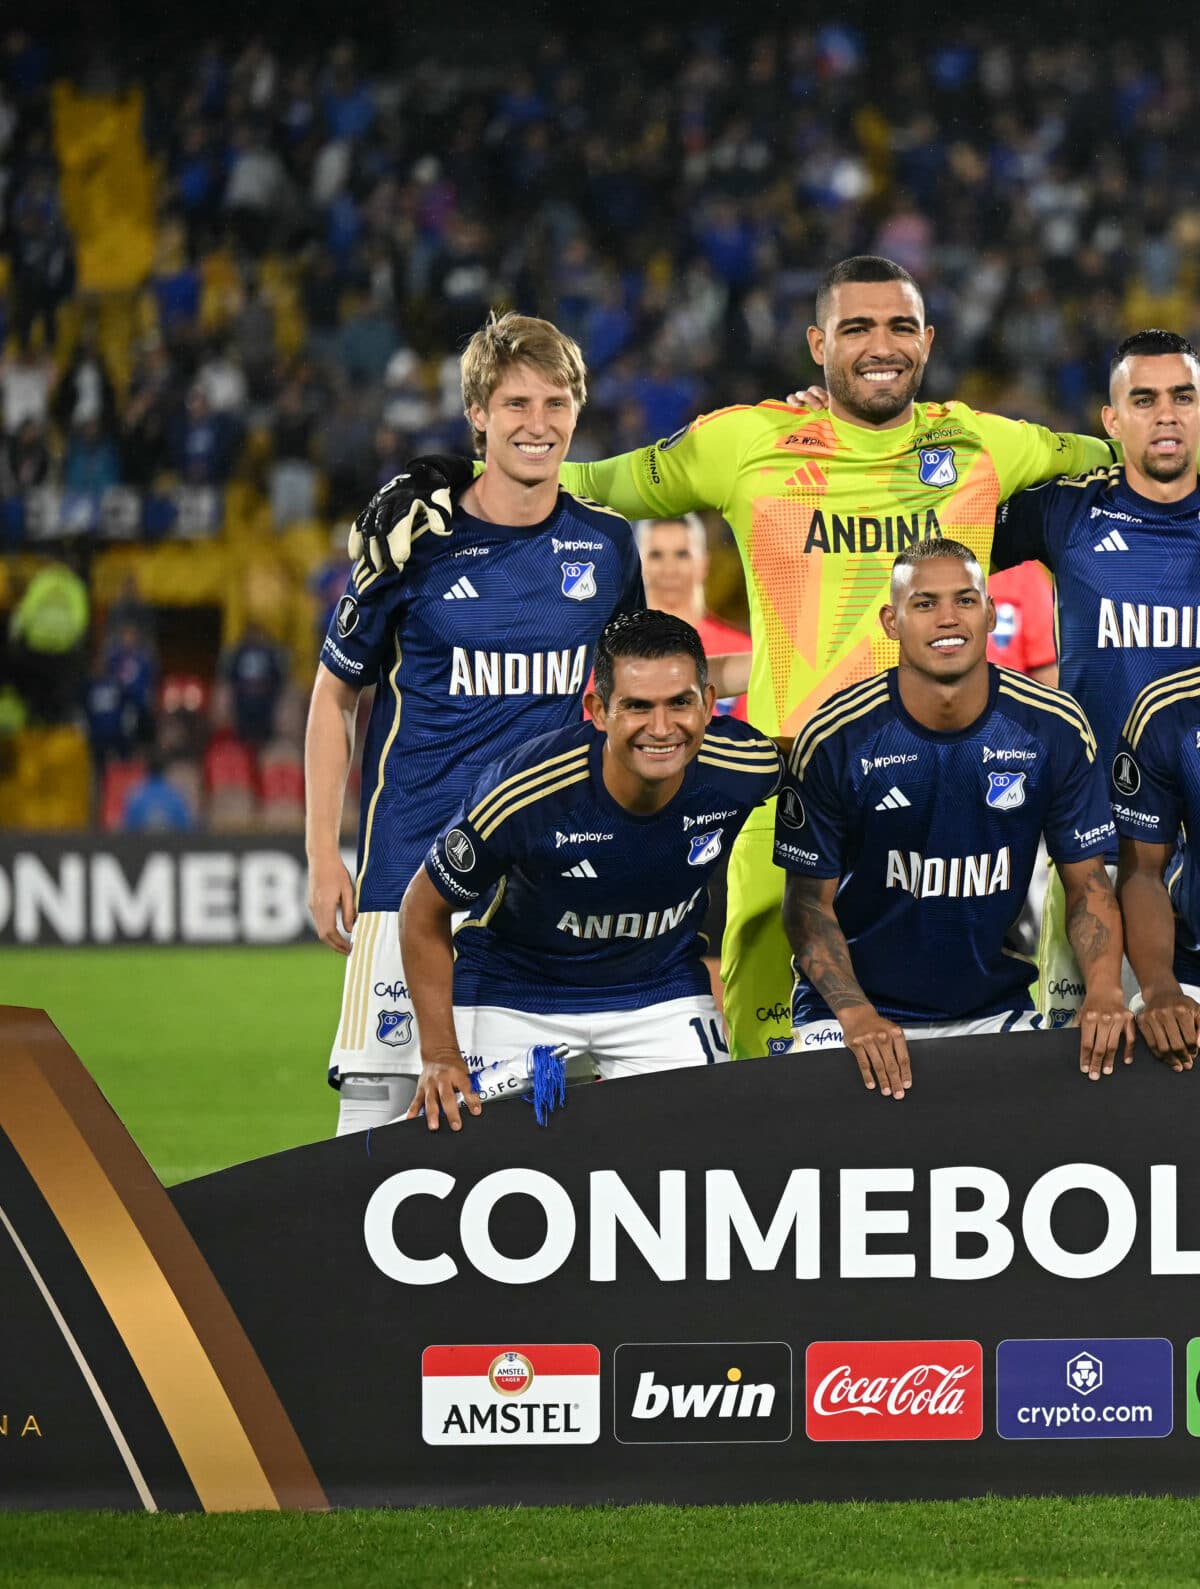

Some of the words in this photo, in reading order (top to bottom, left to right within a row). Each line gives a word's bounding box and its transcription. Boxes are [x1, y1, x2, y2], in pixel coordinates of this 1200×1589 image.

[449, 644, 587, 696] ANDINA
[874, 753, 918, 768] Wplay.co
[570, 831, 614, 844] Wplay.co
[497, 1368, 526, 1376] AMSTEL
[631, 1367, 776, 1420] bwin
[813, 1364, 976, 1417] Coca-Cola
[442, 1402, 581, 1434] AMSTEL
[1017, 1401, 1153, 1428] crypto.com
